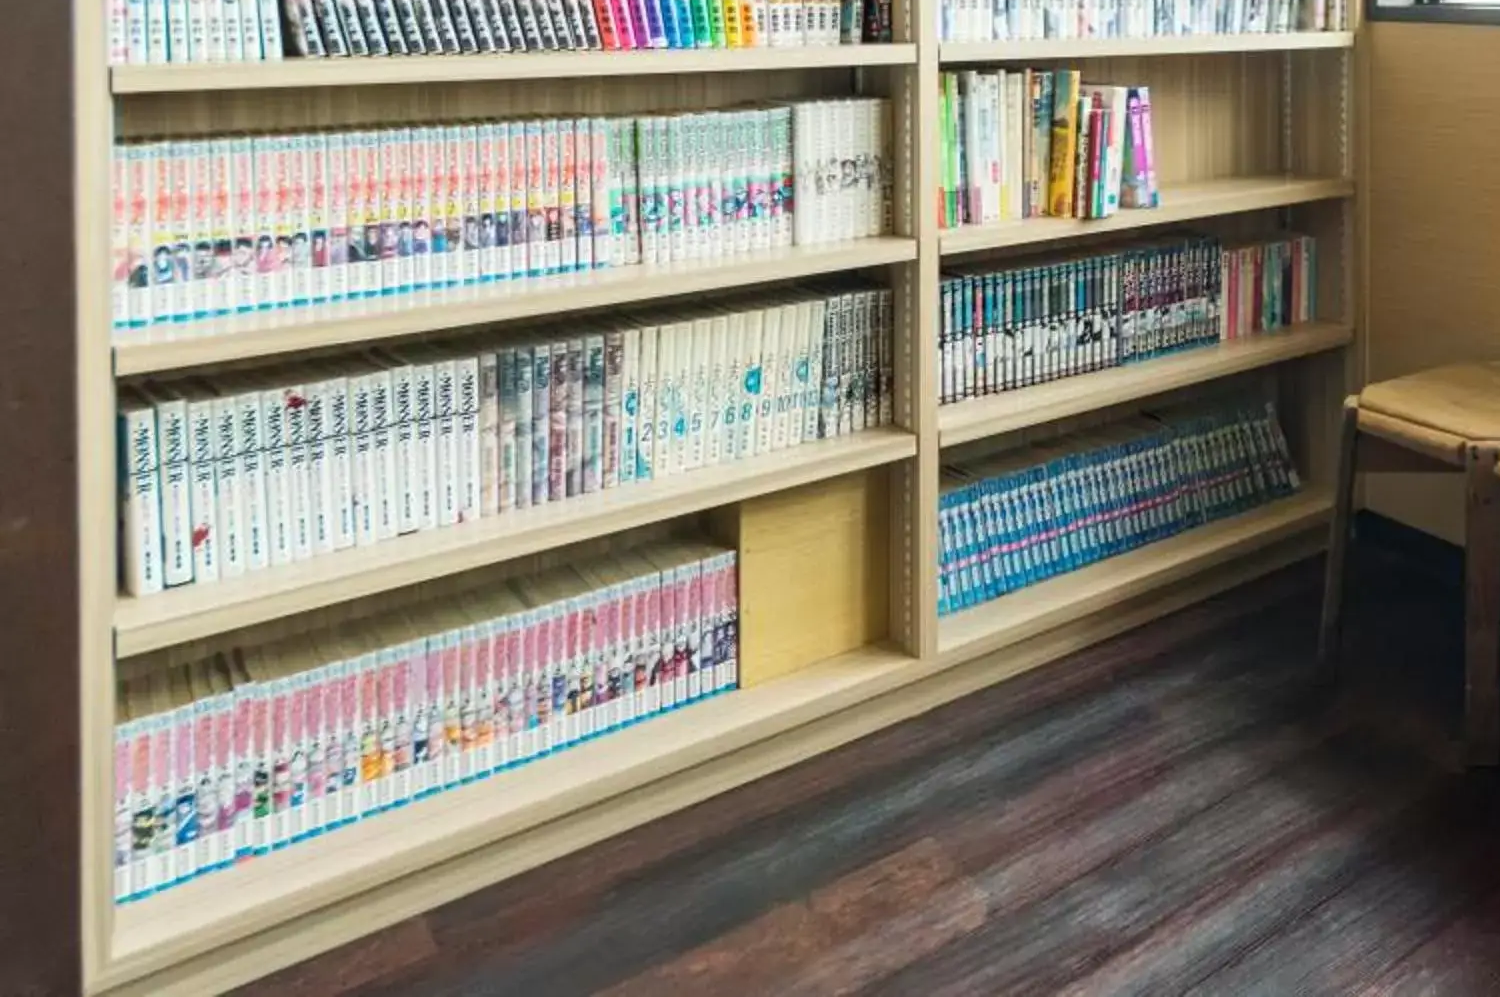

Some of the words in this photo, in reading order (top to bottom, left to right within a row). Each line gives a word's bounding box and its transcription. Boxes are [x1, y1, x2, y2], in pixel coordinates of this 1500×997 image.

[724, 405, 737, 424] 6
[741, 401, 753, 422] 8
[657, 420, 668, 439] 3
[691, 412, 703, 433] 5
